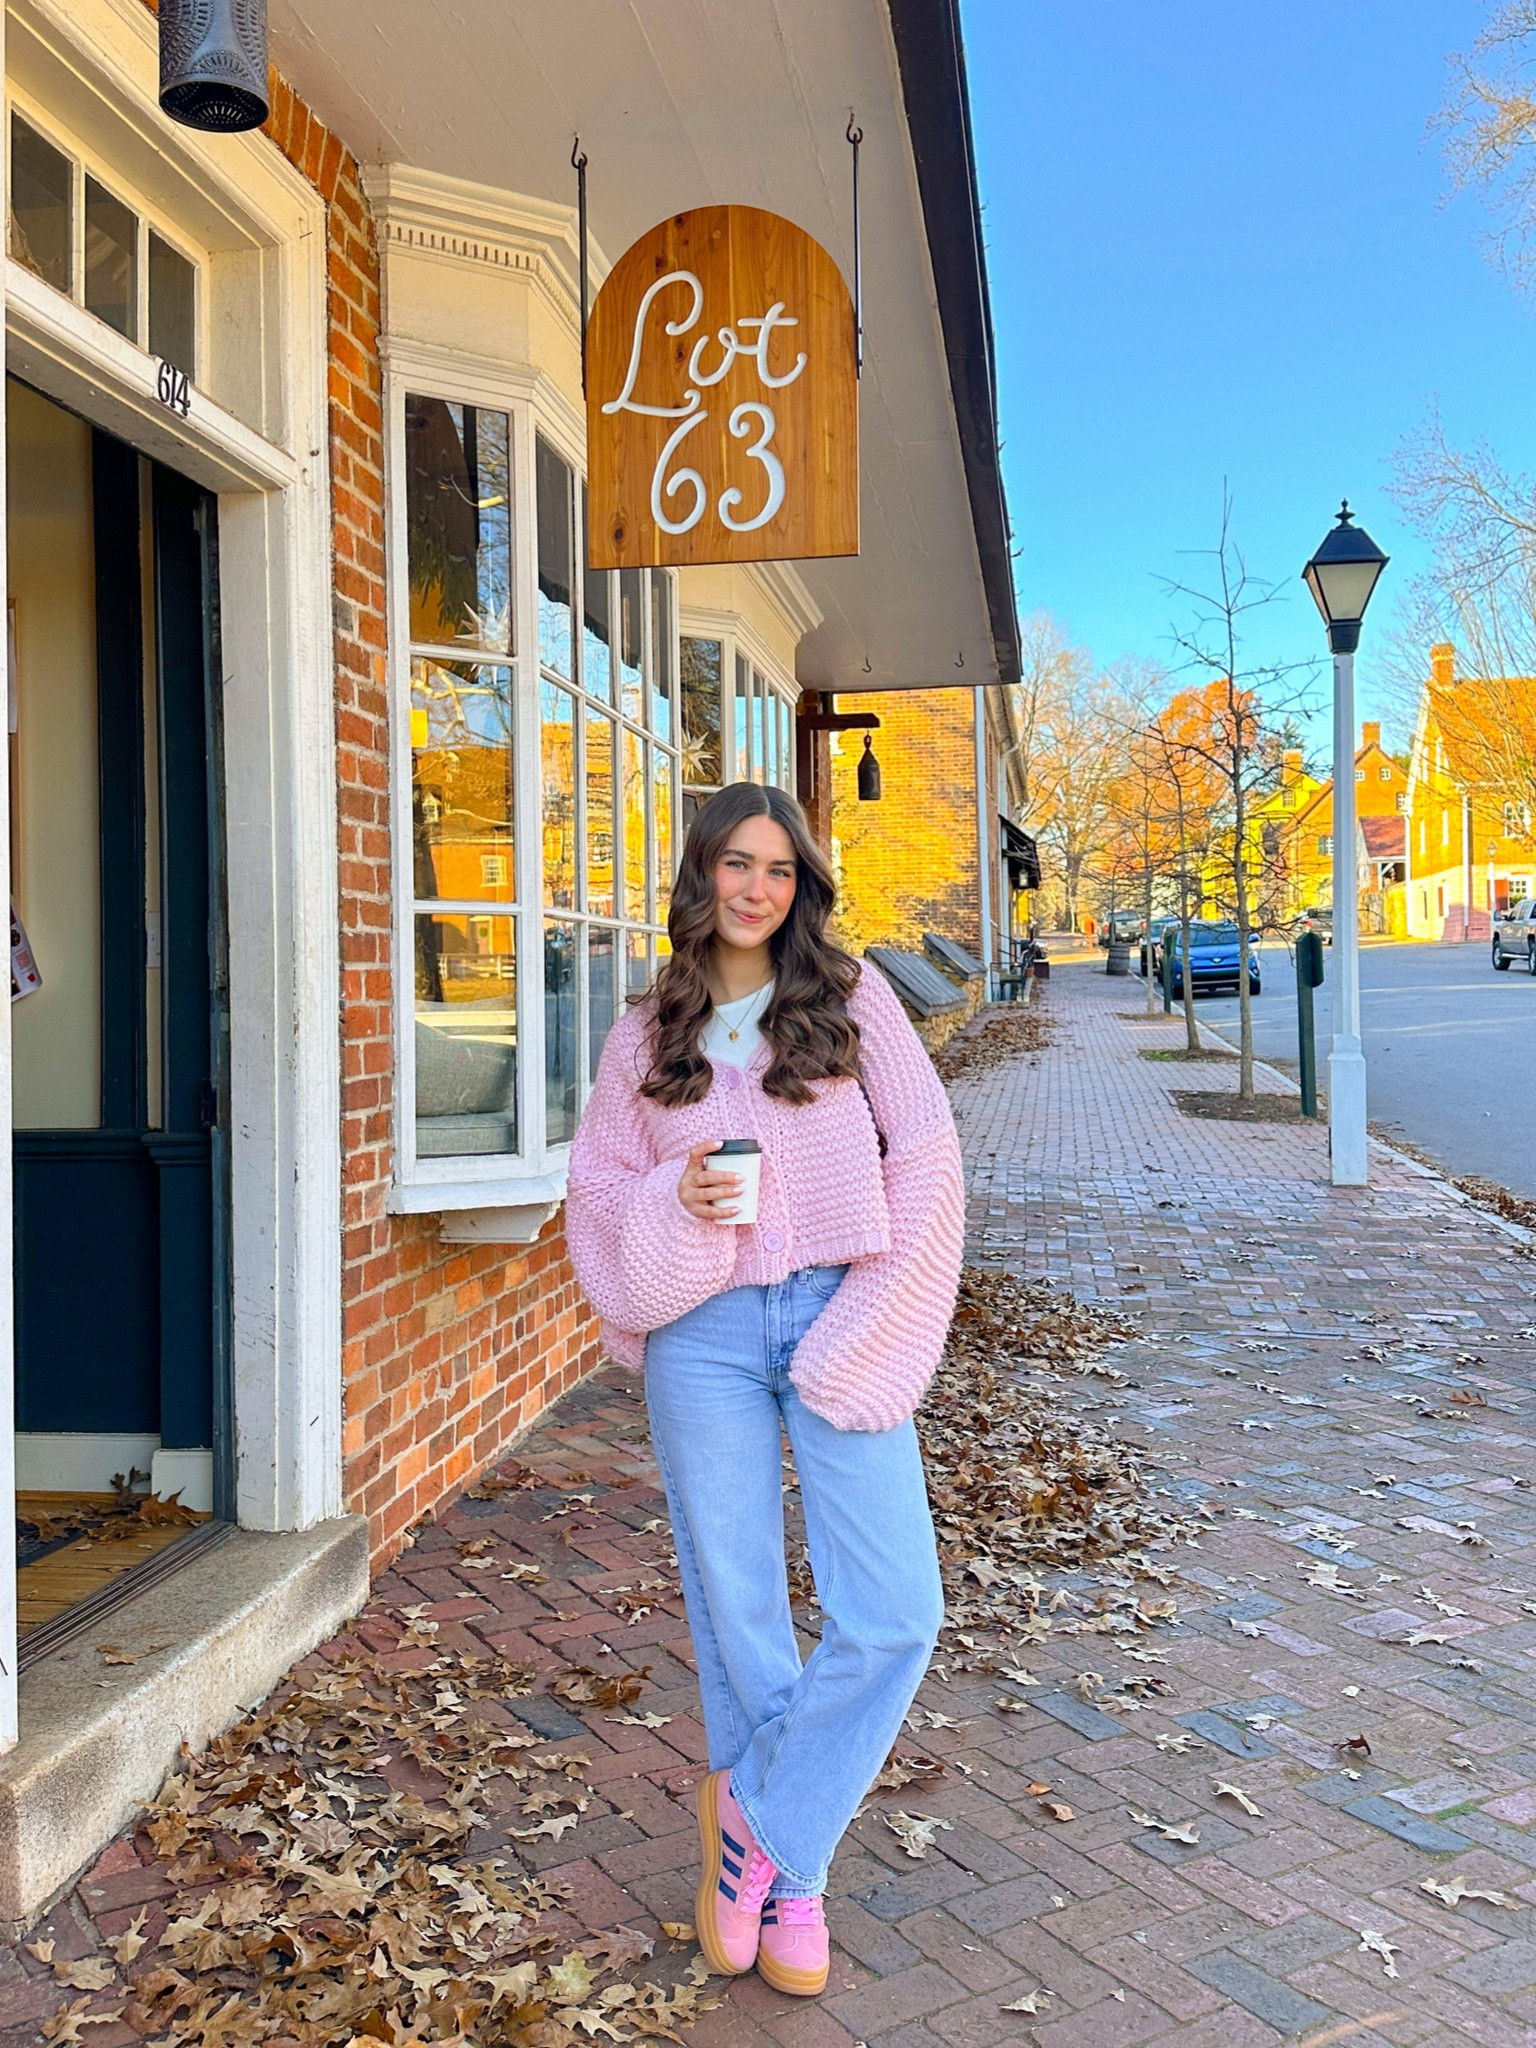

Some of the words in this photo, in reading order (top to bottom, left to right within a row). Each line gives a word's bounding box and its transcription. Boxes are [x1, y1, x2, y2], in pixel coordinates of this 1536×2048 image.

[158, 361, 191, 417] 614
[601, 270, 807, 418] Lot
[650, 401, 786, 535] 63
